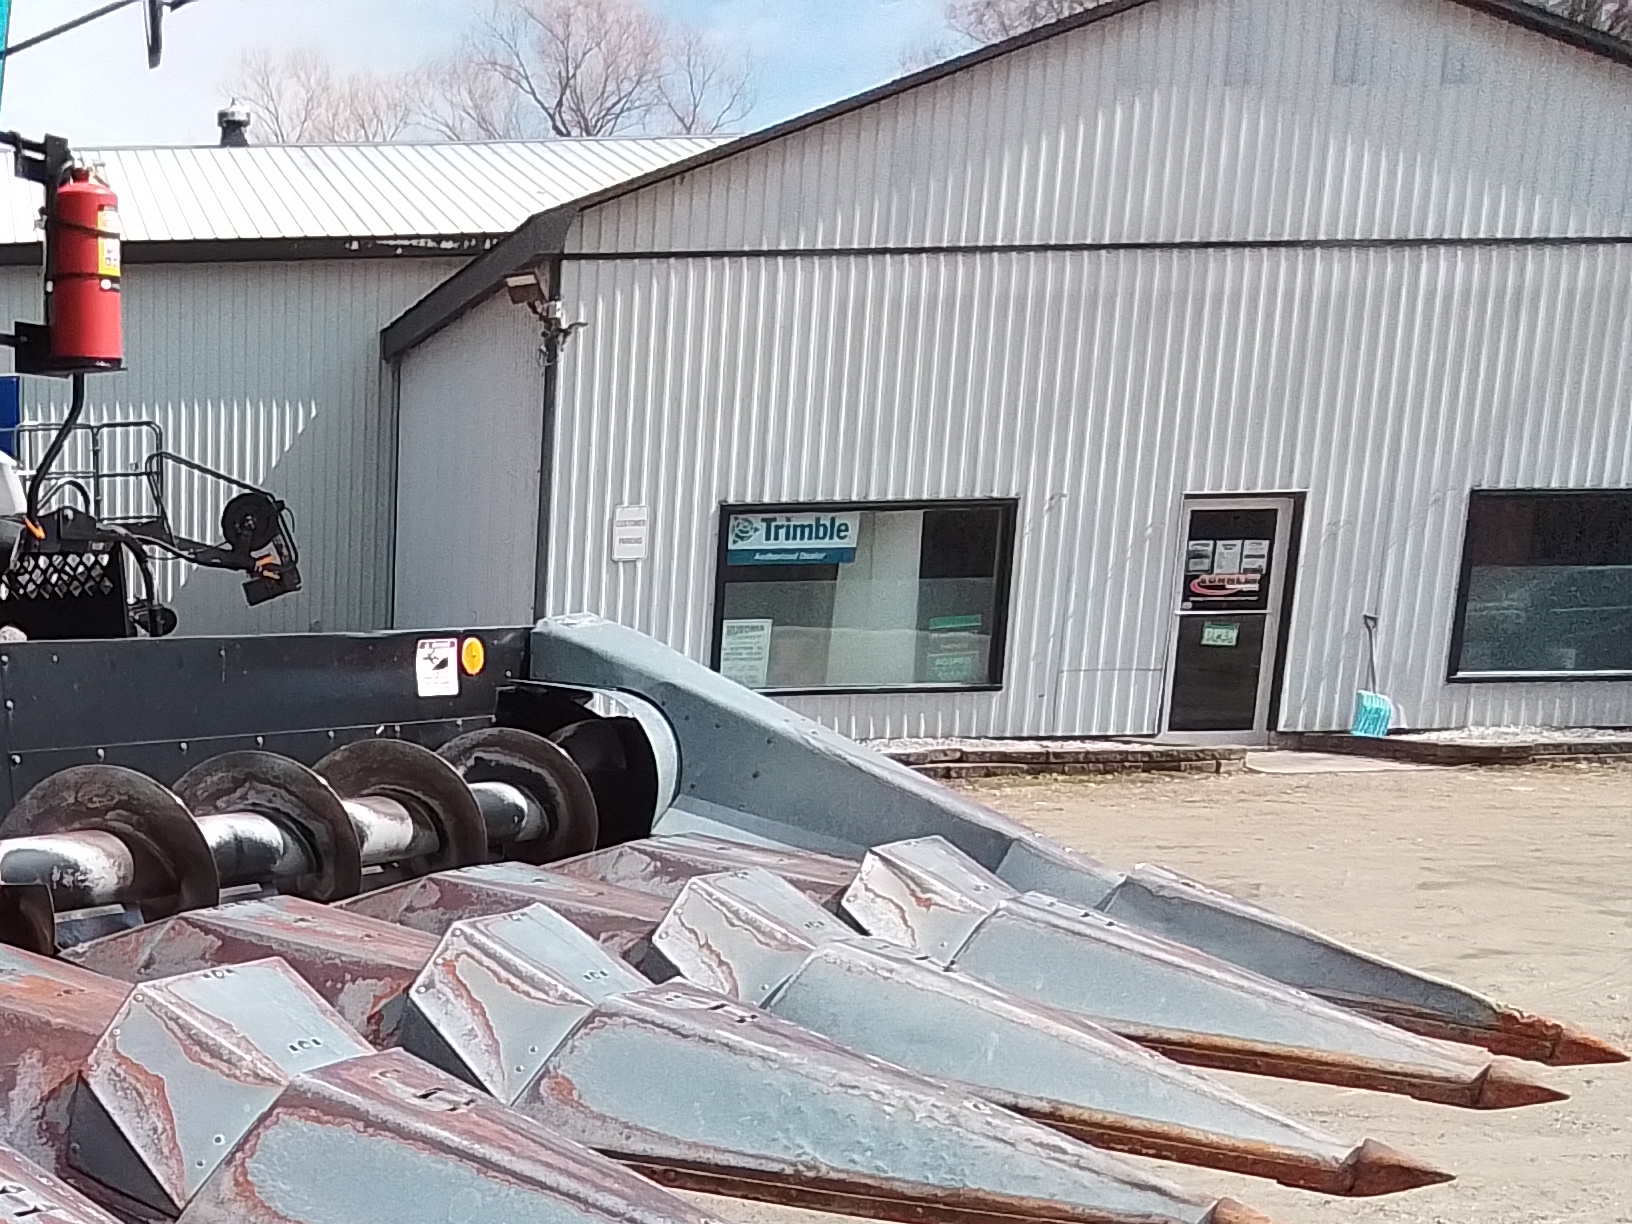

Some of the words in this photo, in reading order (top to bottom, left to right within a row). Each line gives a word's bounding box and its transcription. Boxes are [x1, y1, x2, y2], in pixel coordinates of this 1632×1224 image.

[615, 519, 646, 527] CUSTOMER
[761, 515, 850, 542] Trimble
[618, 537, 643, 545] PARKING
[1203, 626, 1237, 641] OPEN
